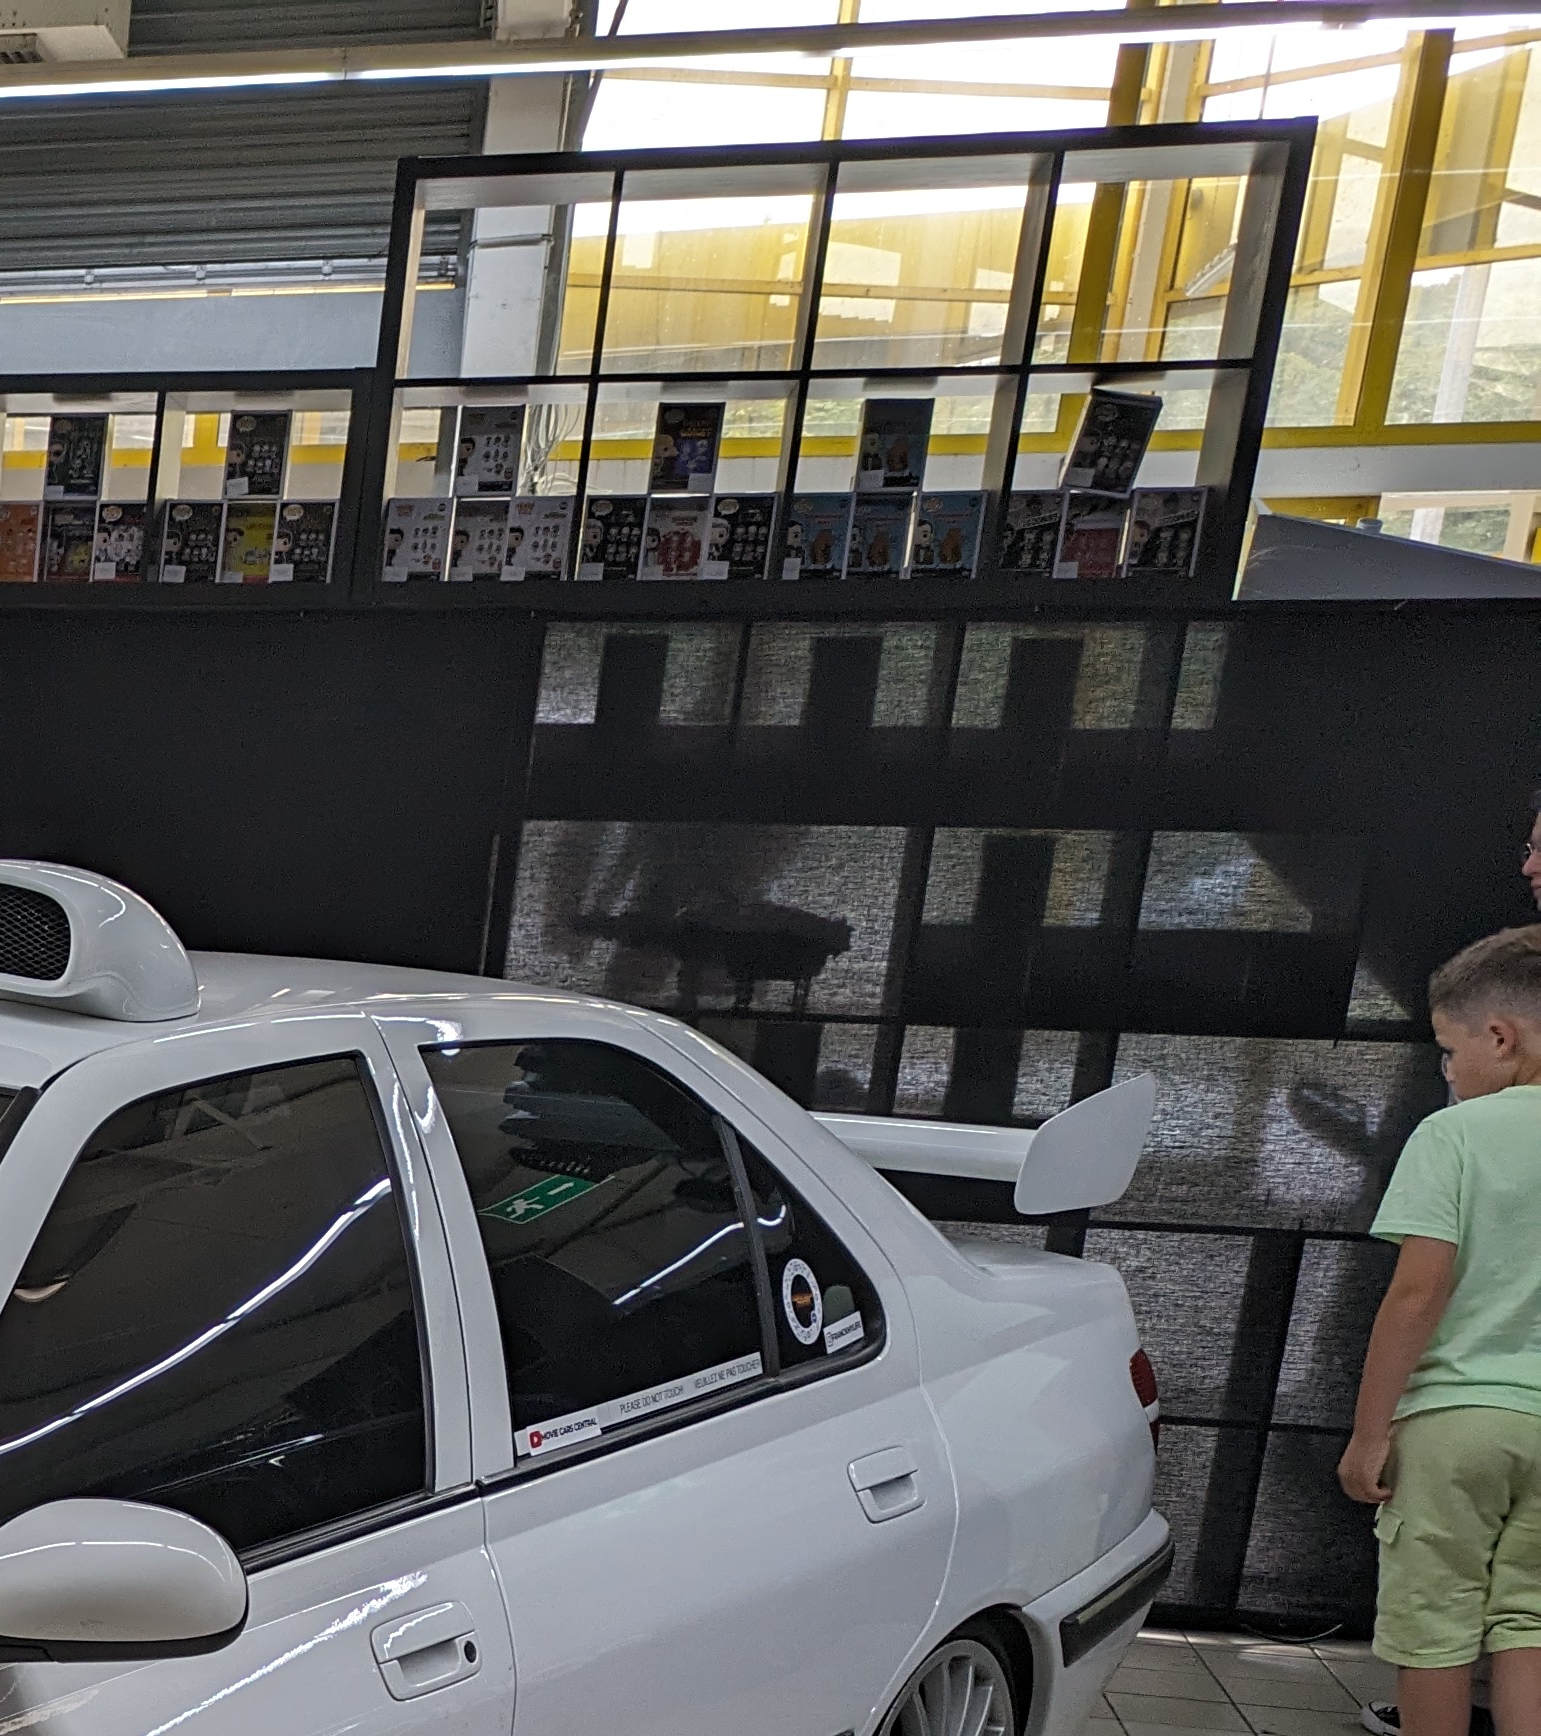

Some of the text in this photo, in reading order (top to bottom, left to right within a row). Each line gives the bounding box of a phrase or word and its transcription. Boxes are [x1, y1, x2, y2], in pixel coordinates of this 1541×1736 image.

[619, 1397, 642, 1415] PLEASE
[642, 1395, 651, 1407] DO
[651, 1391, 664, 1404] NOT
[541, 1417, 598, 1441] MOVIE CARS CENTRAL
